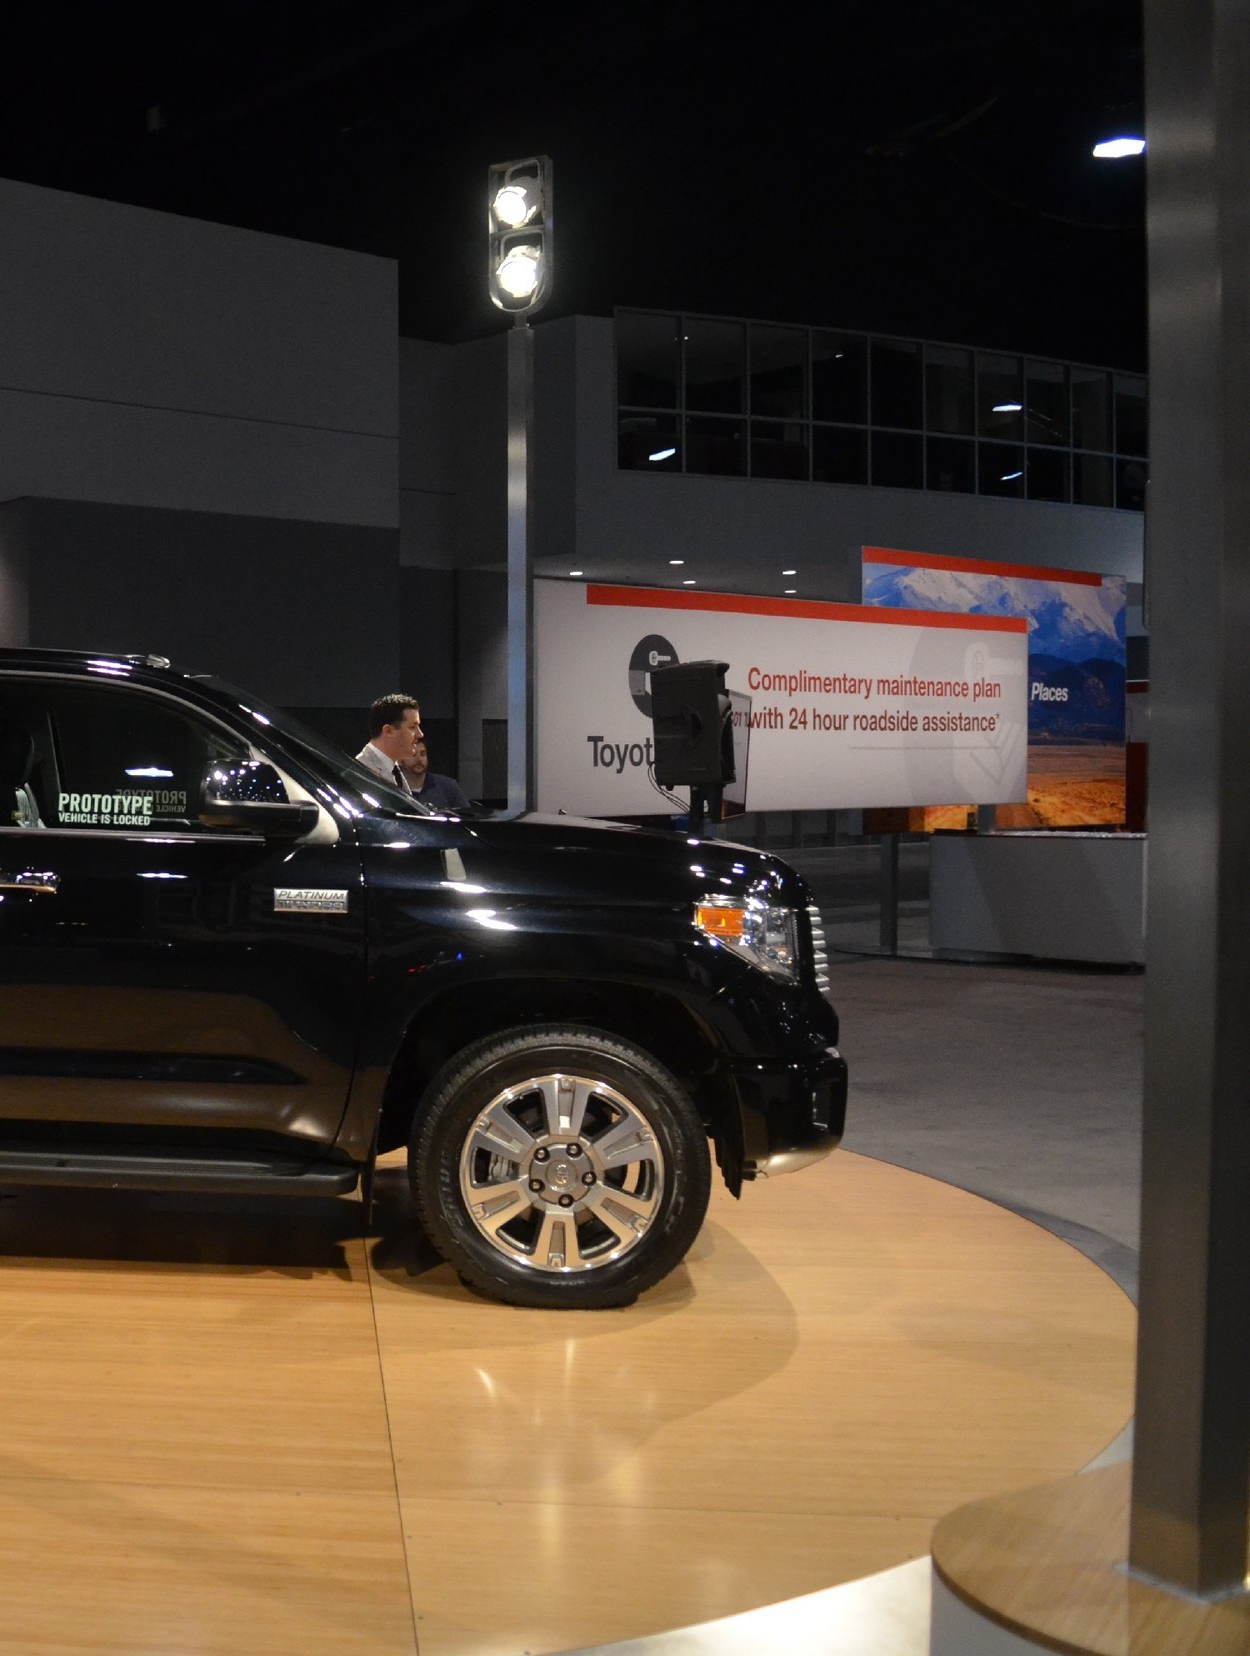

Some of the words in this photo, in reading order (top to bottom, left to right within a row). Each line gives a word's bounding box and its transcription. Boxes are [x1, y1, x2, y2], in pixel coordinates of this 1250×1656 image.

[748, 667, 873, 699] Complimentary
[877, 674, 969, 698] maintenance
[973, 677, 1001, 702] plan
[1031, 682, 1069, 701] Places
[749, 706, 784, 730] with
[789, 707, 808, 730] 24
[813, 708, 849, 731] hour
[853, 709, 918, 732] roadside
[587, 735, 654, 774] Toyot
[58, 793, 153, 815] PROTOTYPE
[58, 812, 98, 824] VEHICLE
[101, 814, 110, 824] IS
[113, 814, 150, 826] LOCKED
[278, 890, 345, 900] PLATINUM
